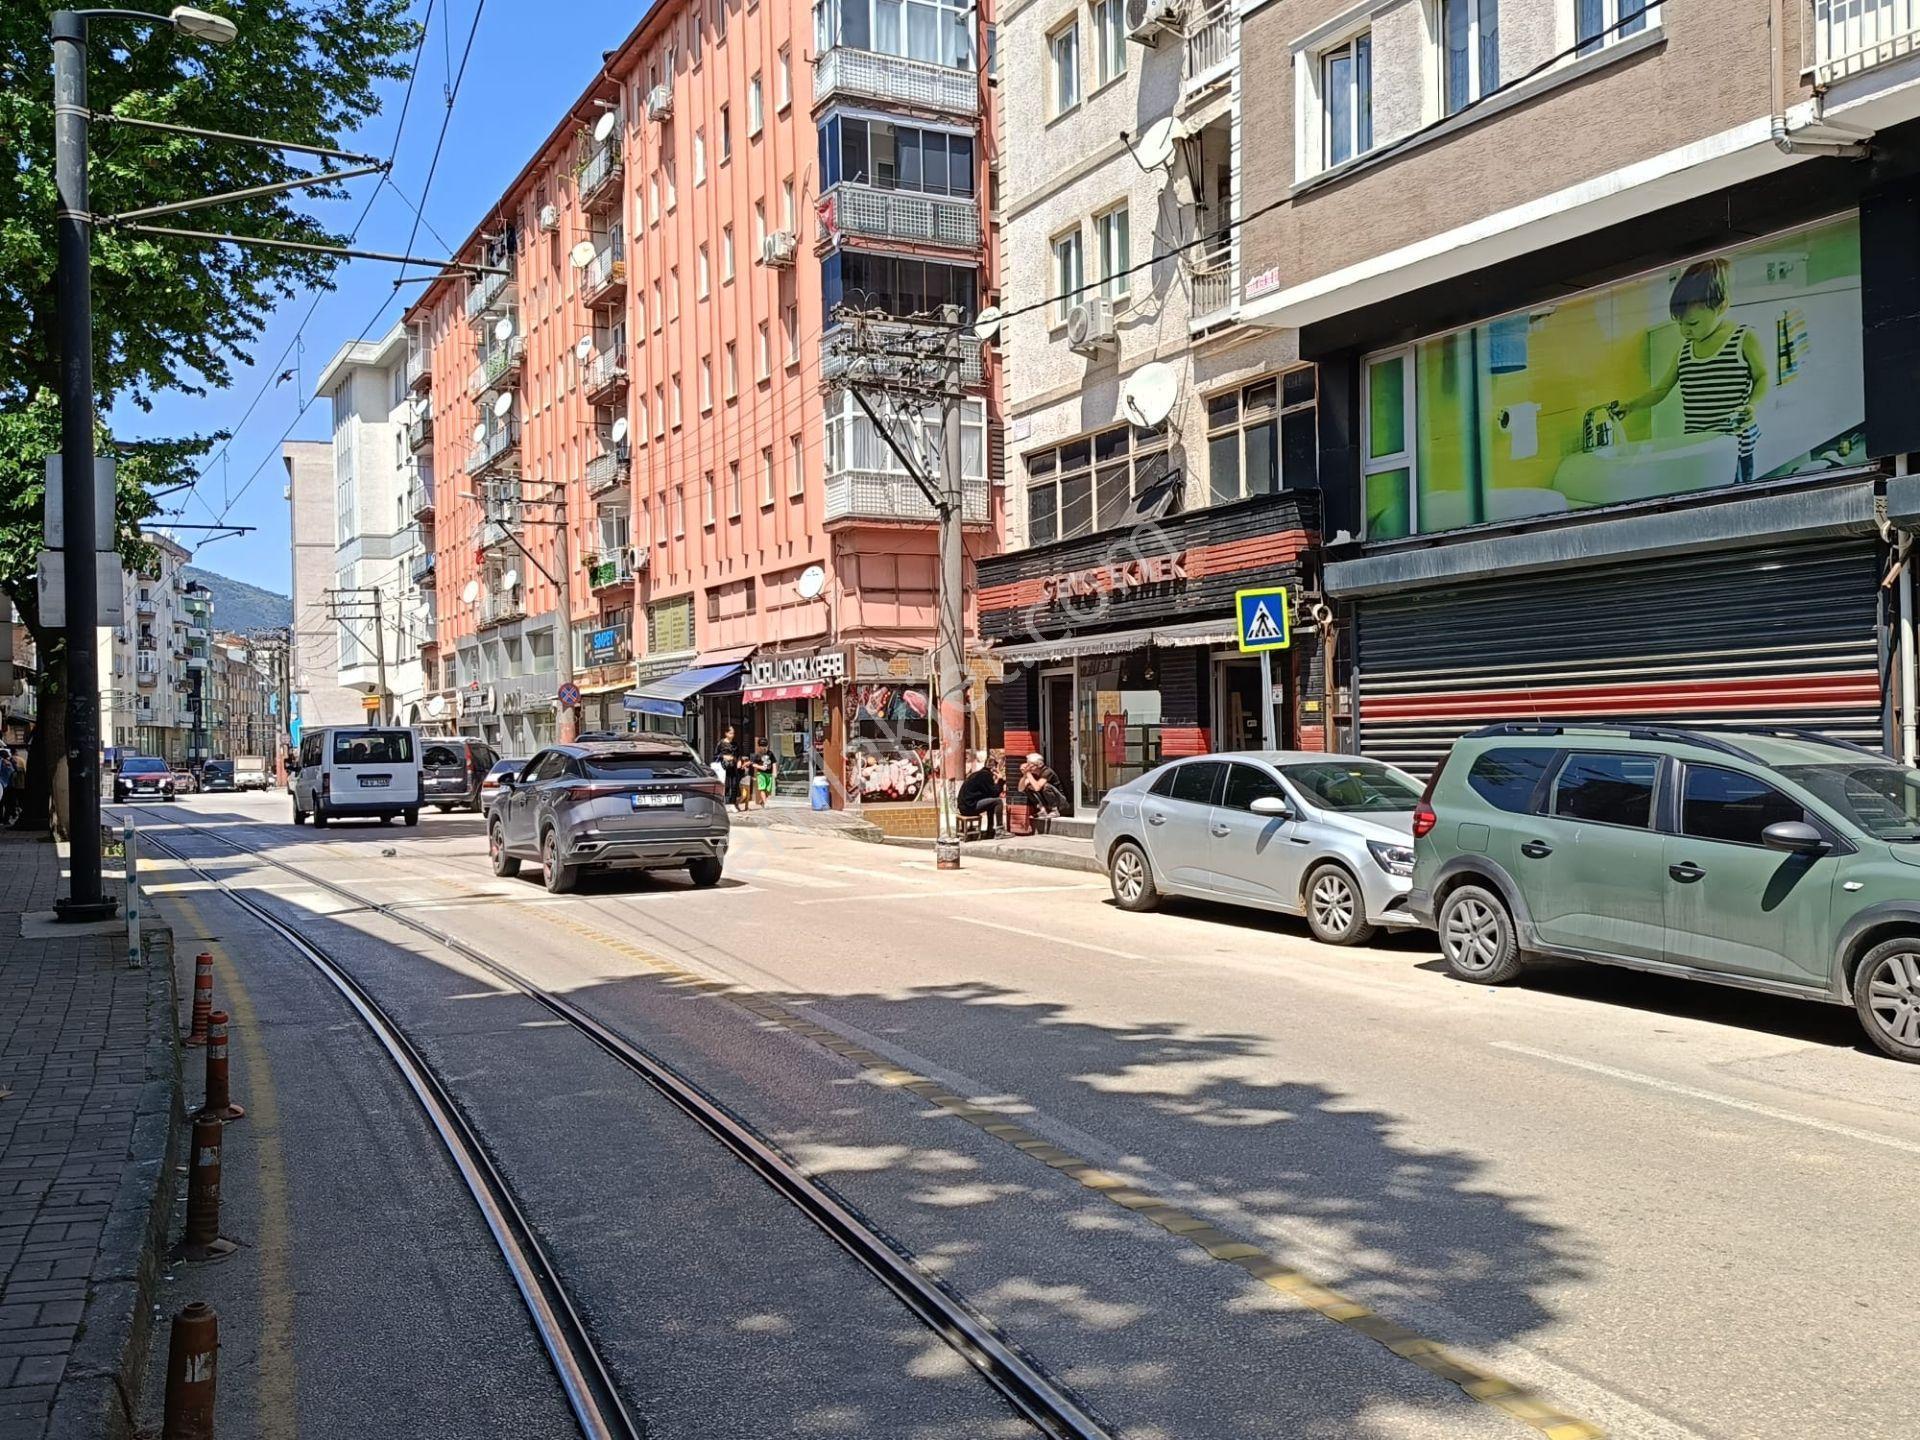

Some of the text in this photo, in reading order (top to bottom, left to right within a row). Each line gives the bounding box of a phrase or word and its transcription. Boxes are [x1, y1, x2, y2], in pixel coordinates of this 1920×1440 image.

[1110, 552, 1188, 588] EKMEK
[779, 656, 809, 682] KONAK
[809, 652, 845, 680] KASABI
